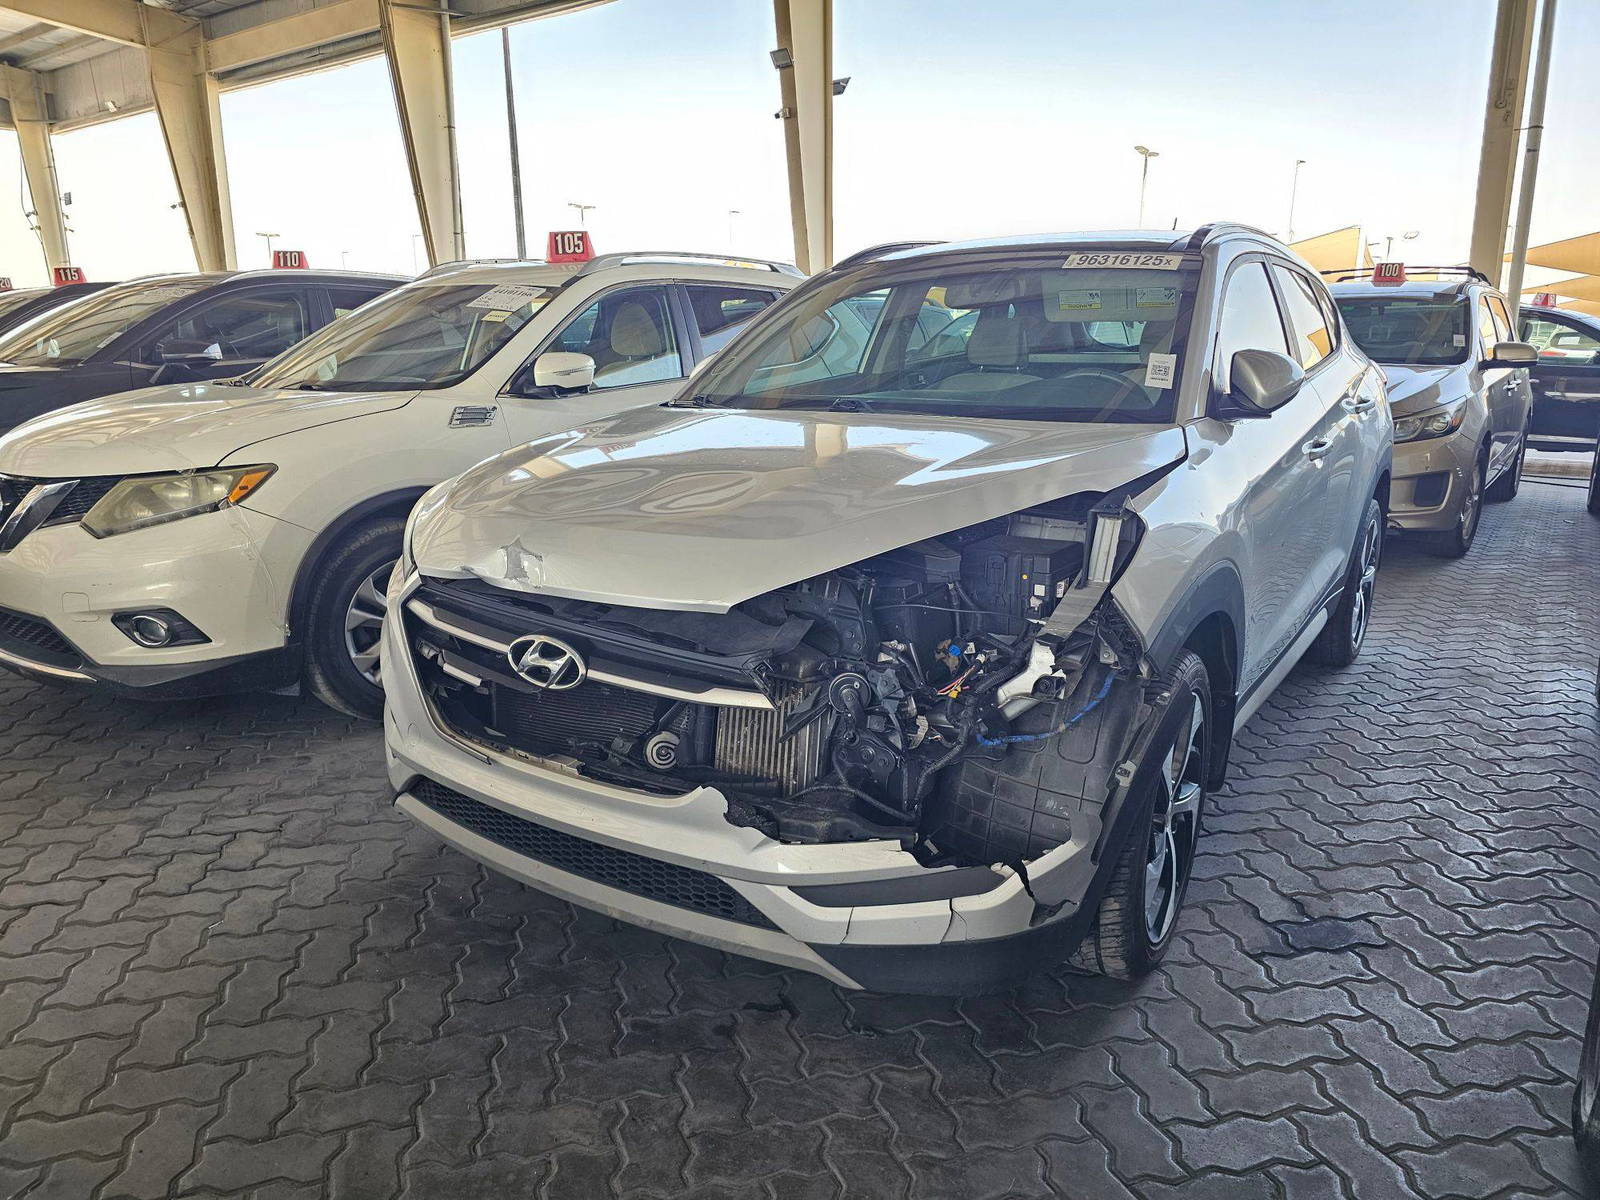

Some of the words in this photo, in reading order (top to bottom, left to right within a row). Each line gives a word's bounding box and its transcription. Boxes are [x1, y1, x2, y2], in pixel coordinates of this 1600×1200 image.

[555, 233, 584, 255] 105
[279, 251, 299, 267] 110
[60, 268, 79, 281] 115
[1381, 263, 1399, 277] 100
